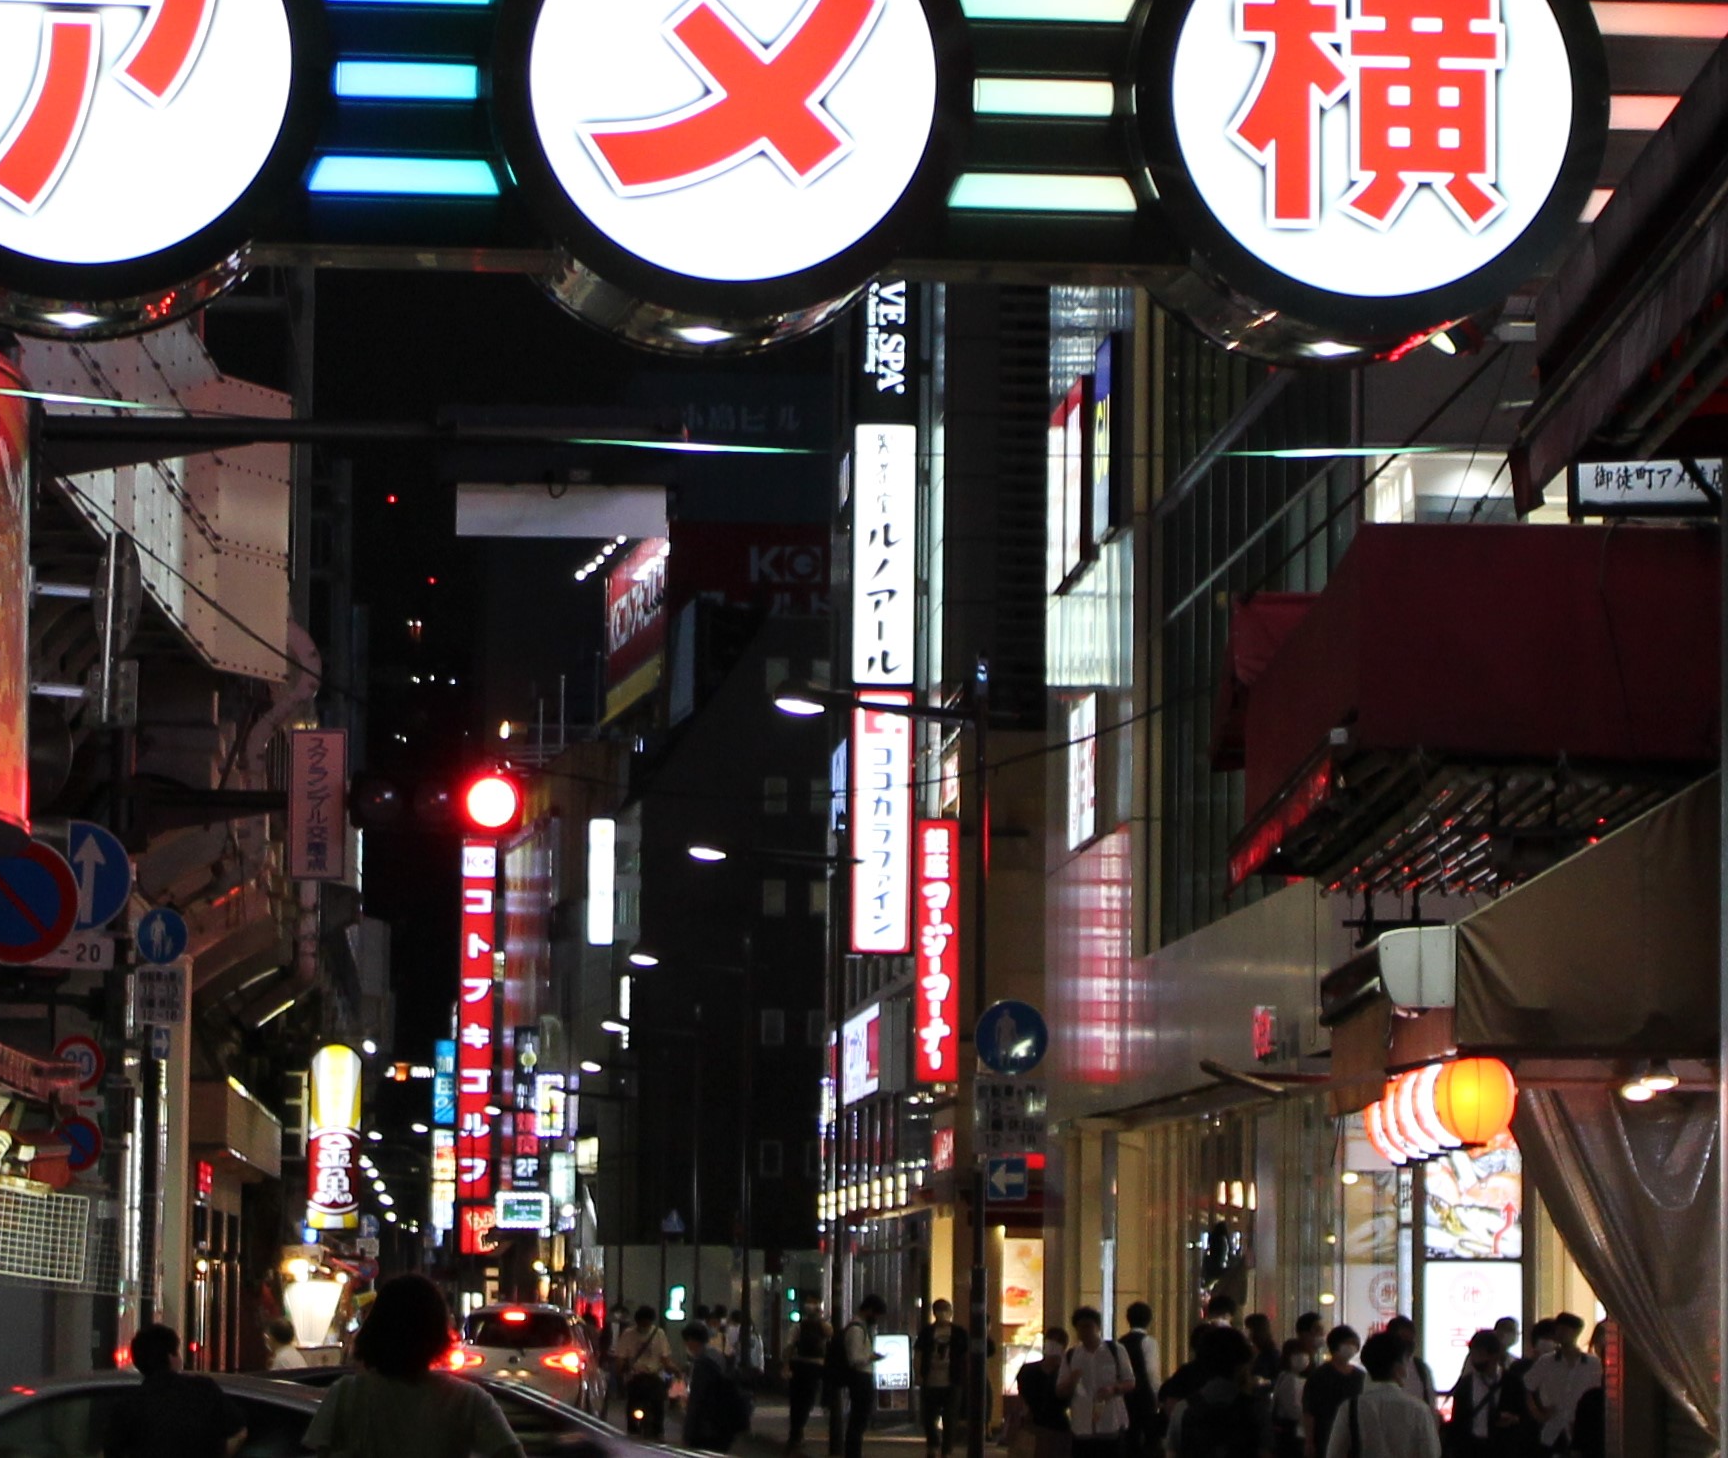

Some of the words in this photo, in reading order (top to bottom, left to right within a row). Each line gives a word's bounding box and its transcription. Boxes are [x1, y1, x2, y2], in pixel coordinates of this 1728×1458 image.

[870, 746, 894, 936] ココカラファイン
[459, 888, 493, 1183] コトブキゴルフ
